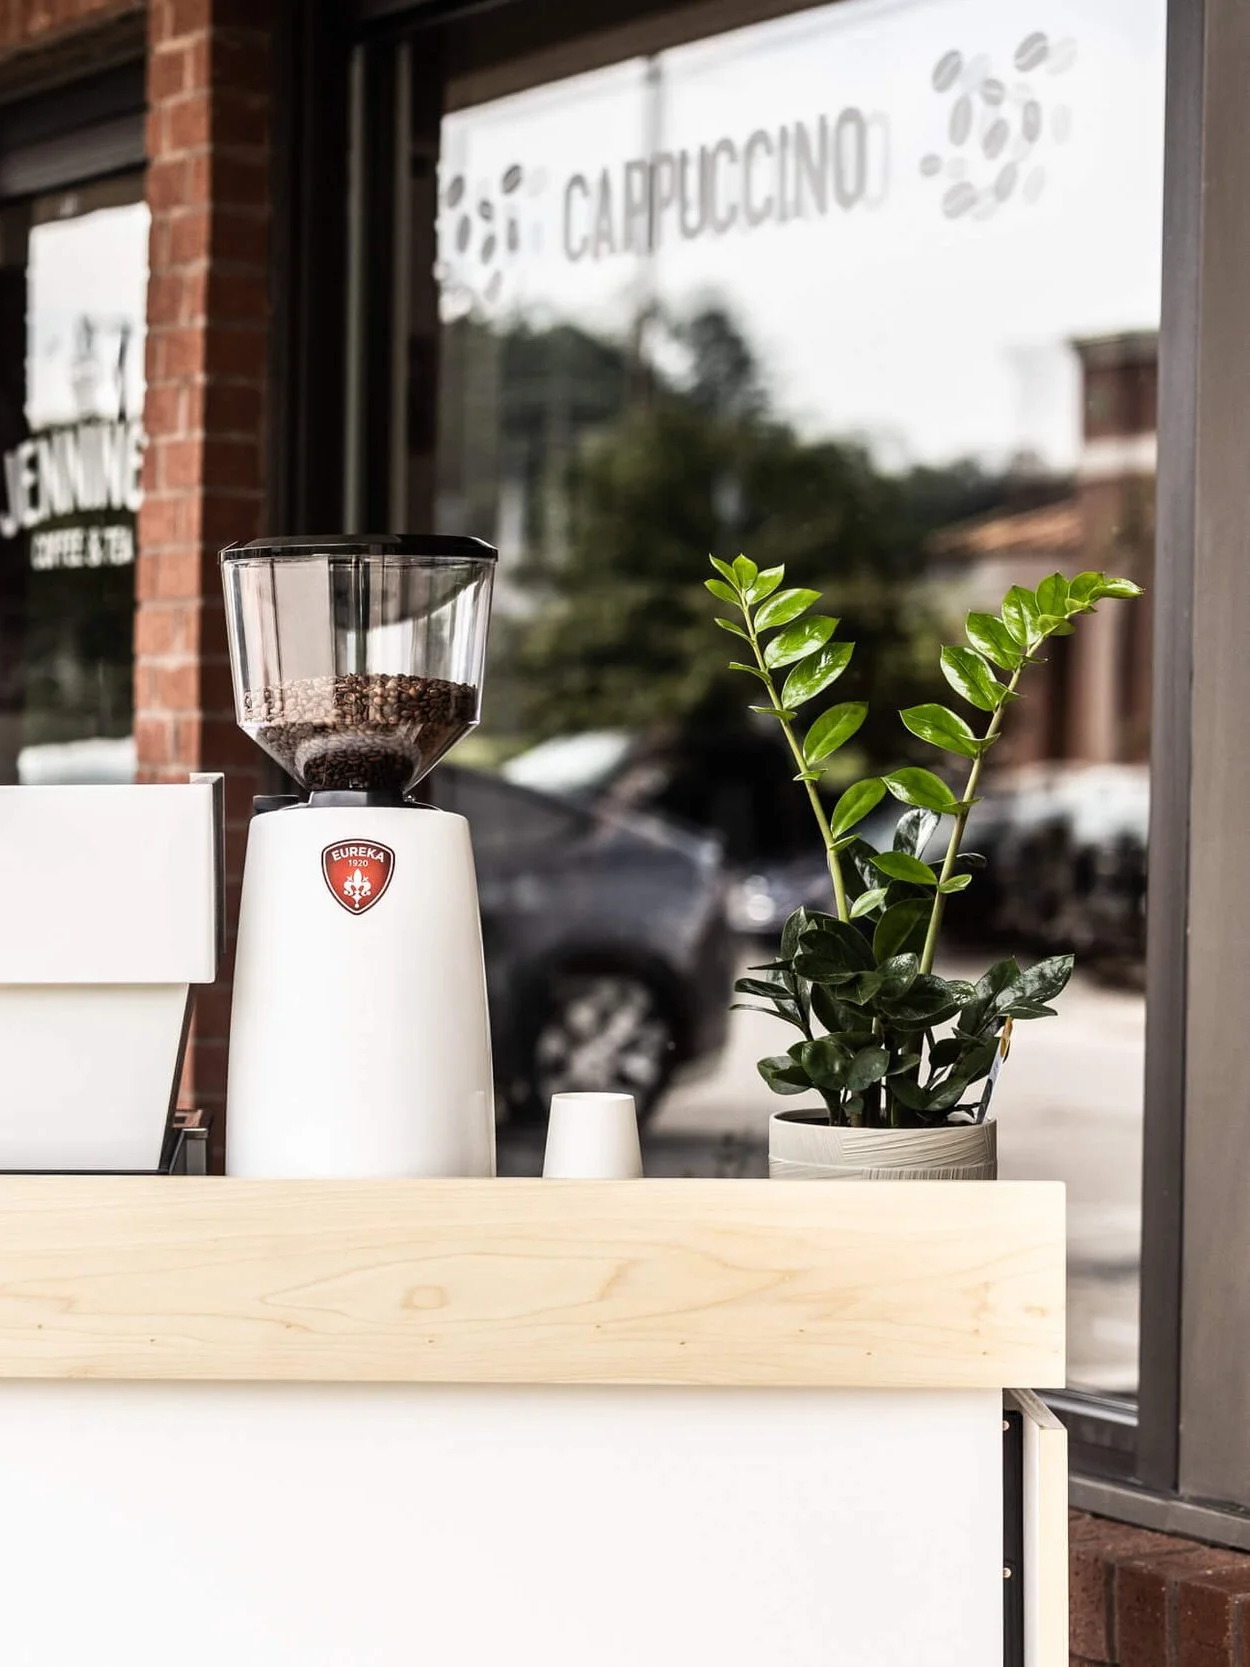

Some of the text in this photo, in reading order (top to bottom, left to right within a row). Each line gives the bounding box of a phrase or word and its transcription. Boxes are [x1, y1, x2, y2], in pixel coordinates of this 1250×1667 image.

[563, 106, 868, 263] CAPPUCCINO
[331, 846, 385, 863] EUREKA
[348, 859, 369, 867] 1920
